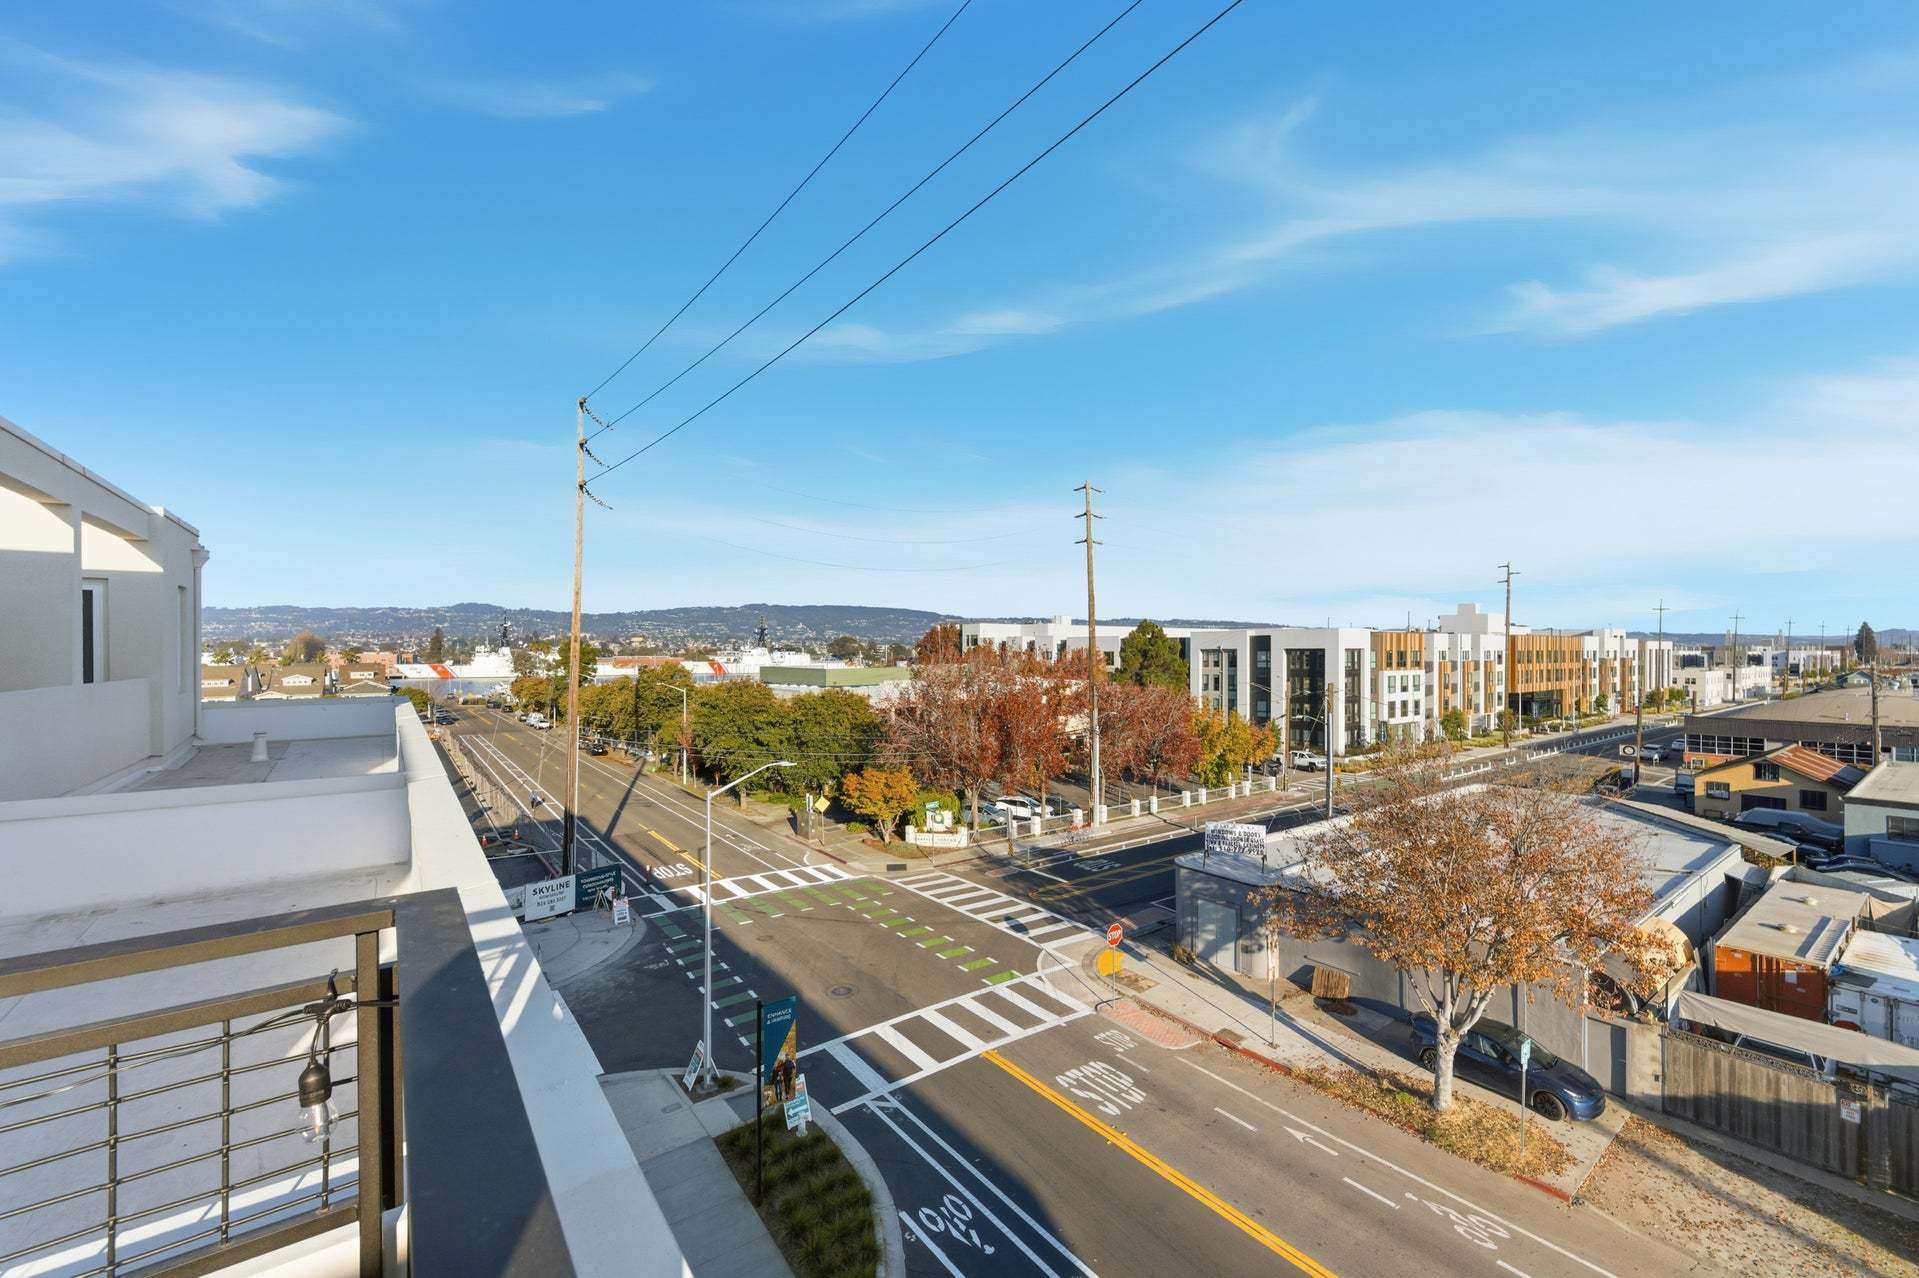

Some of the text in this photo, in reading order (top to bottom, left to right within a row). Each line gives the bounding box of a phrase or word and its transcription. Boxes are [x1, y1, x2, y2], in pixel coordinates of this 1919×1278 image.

[1210, 829, 1237, 837] WINDOWS
[653, 863, 694, 880] STOP
[532, 880, 570, 896] SKYLINE
[1108, 929, 1121, 941] STOP
[1055, 1061, 1147, 1116] STOP
